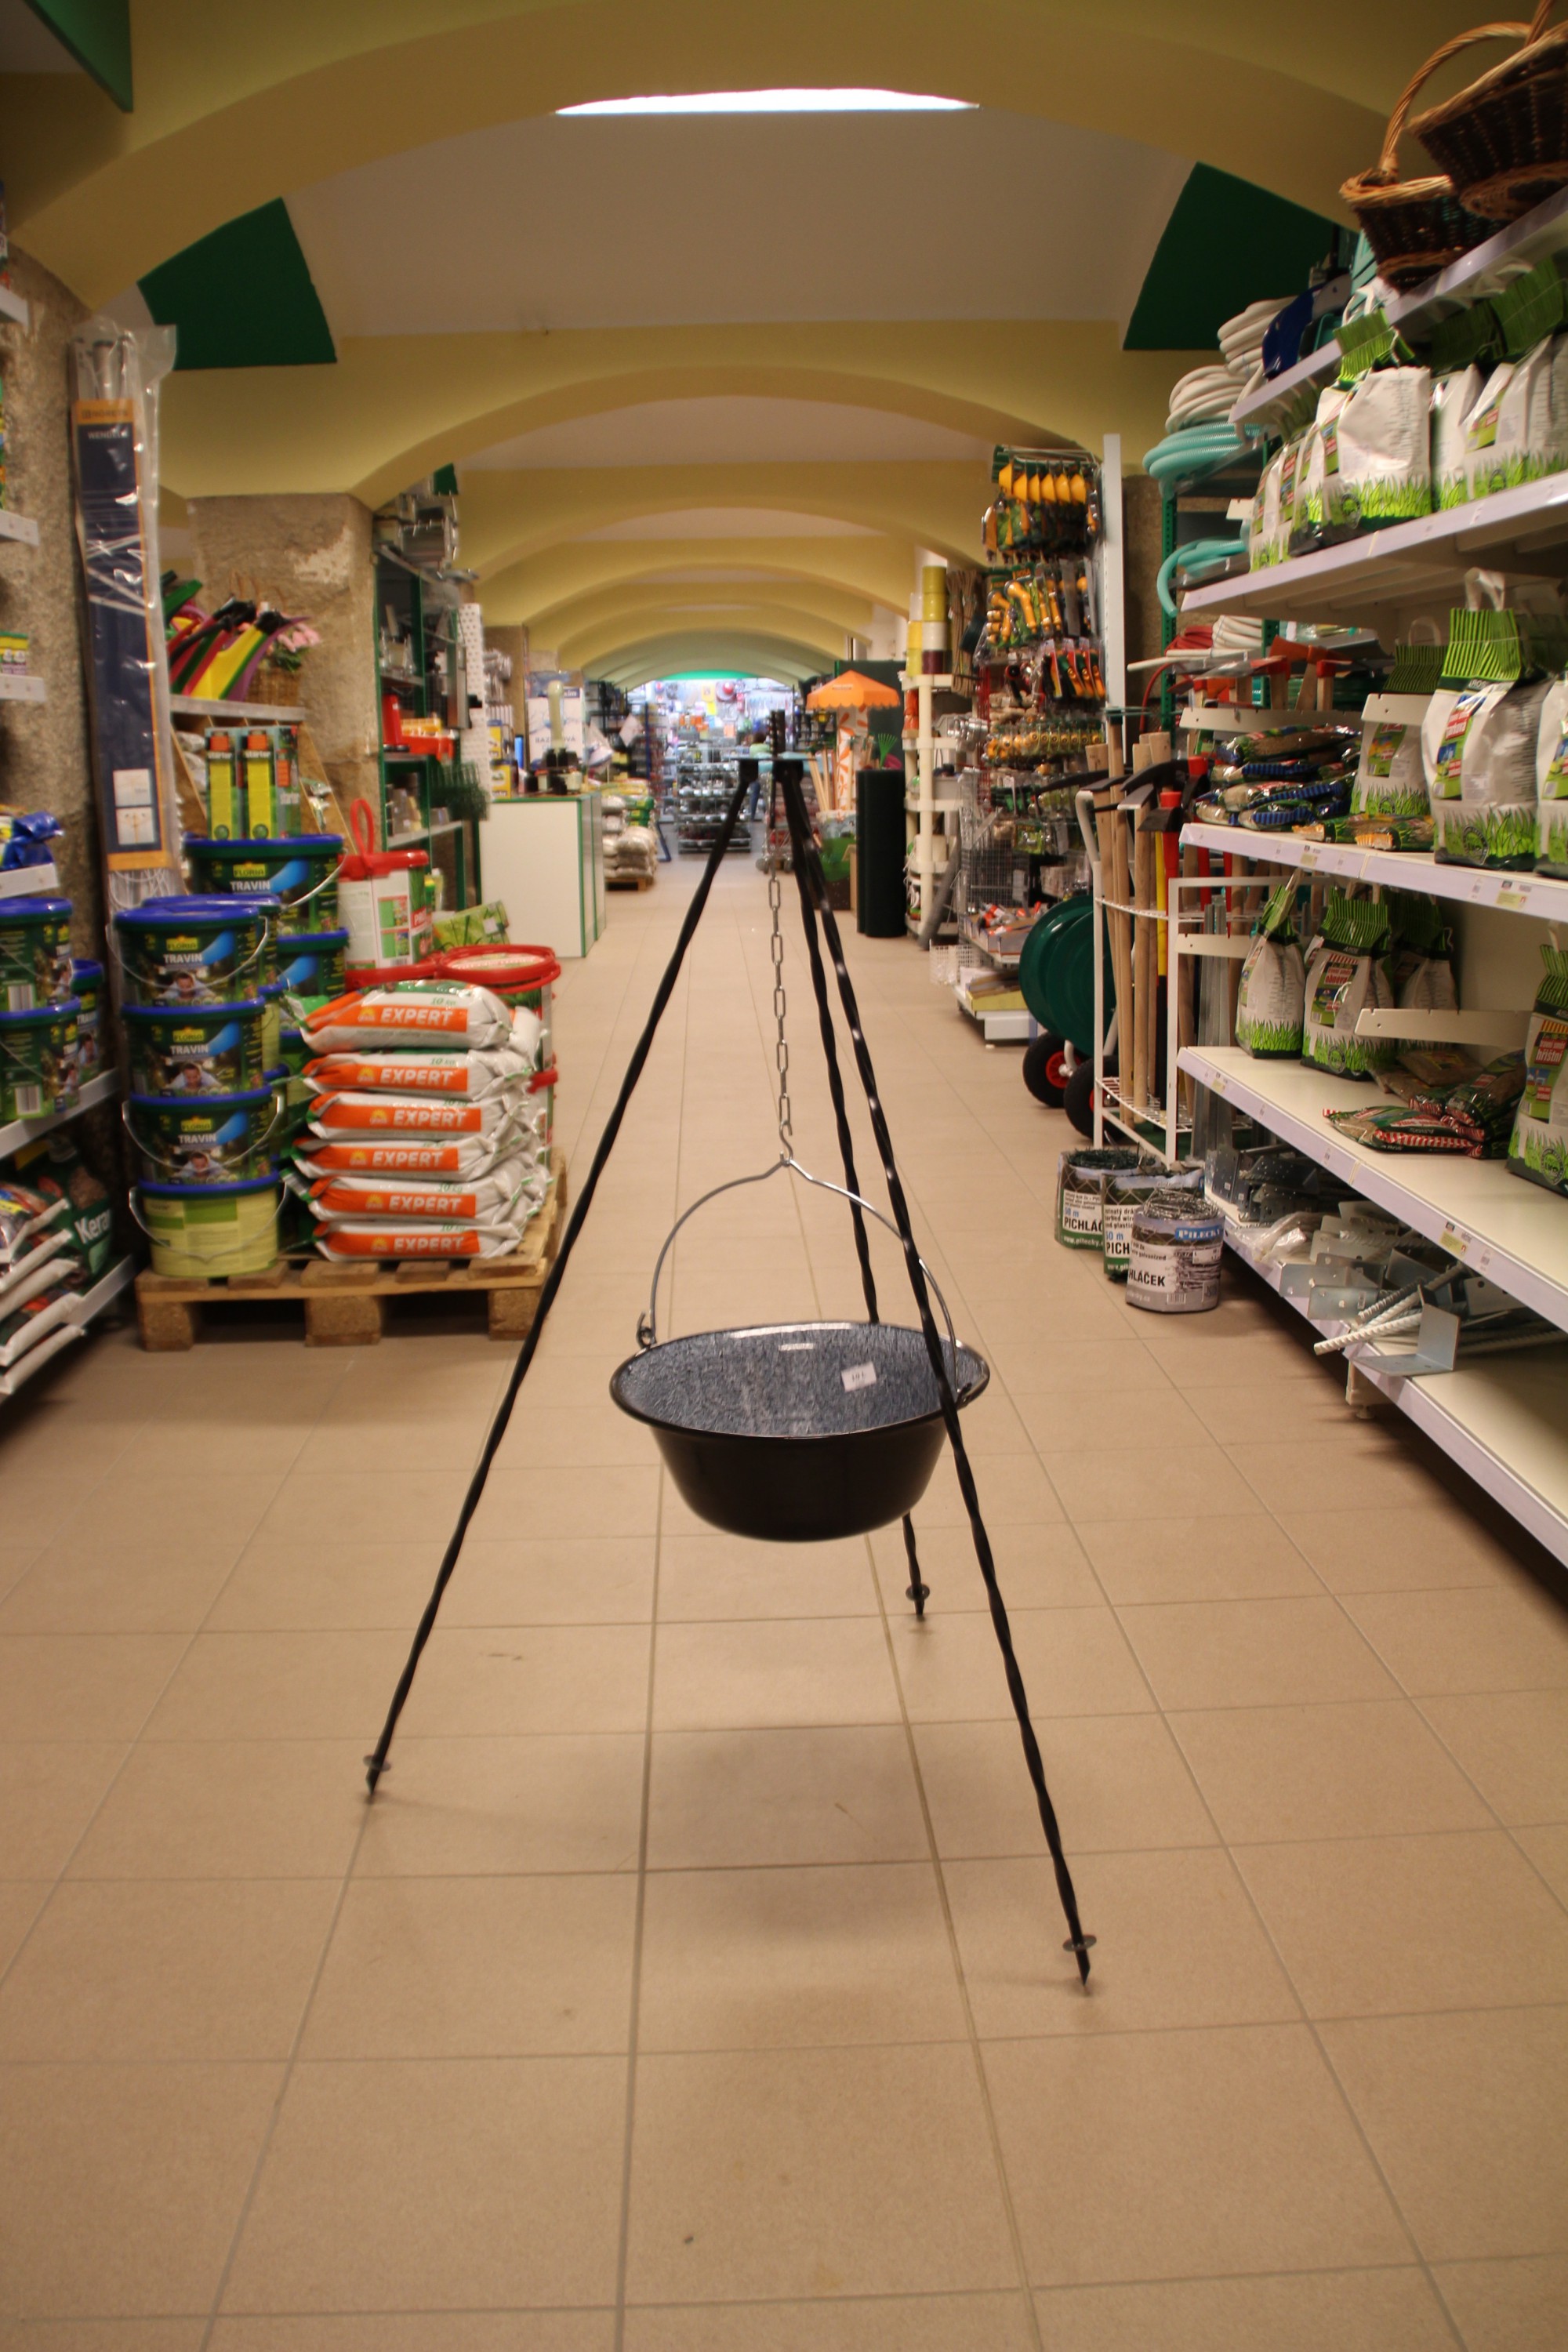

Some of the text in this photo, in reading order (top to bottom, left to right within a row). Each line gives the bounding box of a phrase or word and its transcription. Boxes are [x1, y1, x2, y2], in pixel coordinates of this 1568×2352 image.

[230, 880, 270, 891] TRAVIN
[163, 953, 203, 964] TRAVIN
[380, 1007, 453, 1026] EXPERT
[169, 1044, 209, 1055] TRAVIN
[379, 1068, 453, 1087] EXPERT
[393, 1109, 467, 1128] EXPERT
[178, 1134, 217, 1144] TRAVIN
[372, 1150, 443, 1168] EXPERT
[389, 1195, 462, 1214] EXPERT
[394, 1236, 465, 1254] EXPERT
